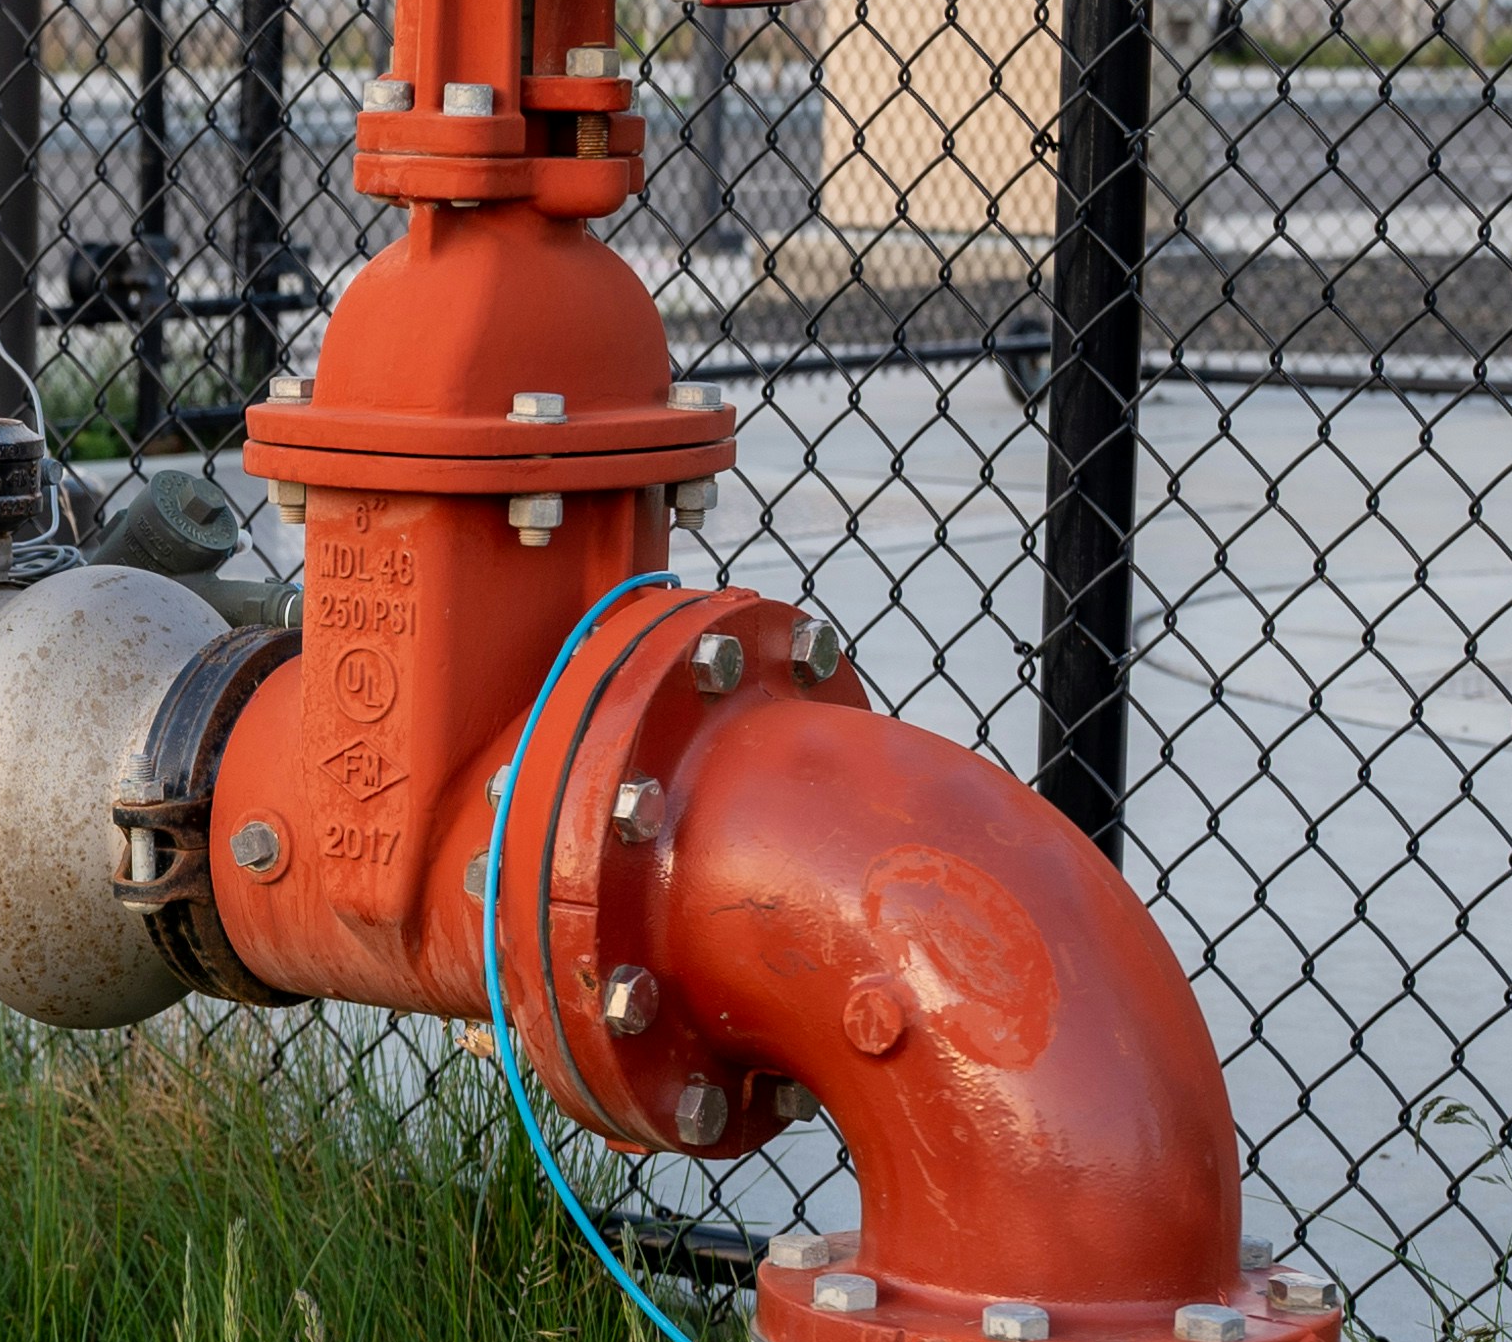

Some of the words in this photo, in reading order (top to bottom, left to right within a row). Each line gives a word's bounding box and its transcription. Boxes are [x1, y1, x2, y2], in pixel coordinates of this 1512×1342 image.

[318, 543, 373, 583] MDL
[318, 594, 367, 631] 250
[373, 598, 417, 637] PSI
[344, 659, 384, 709] UL
[342, 752, 383, 789] FM
[324, 822, 402, 867] 2017
